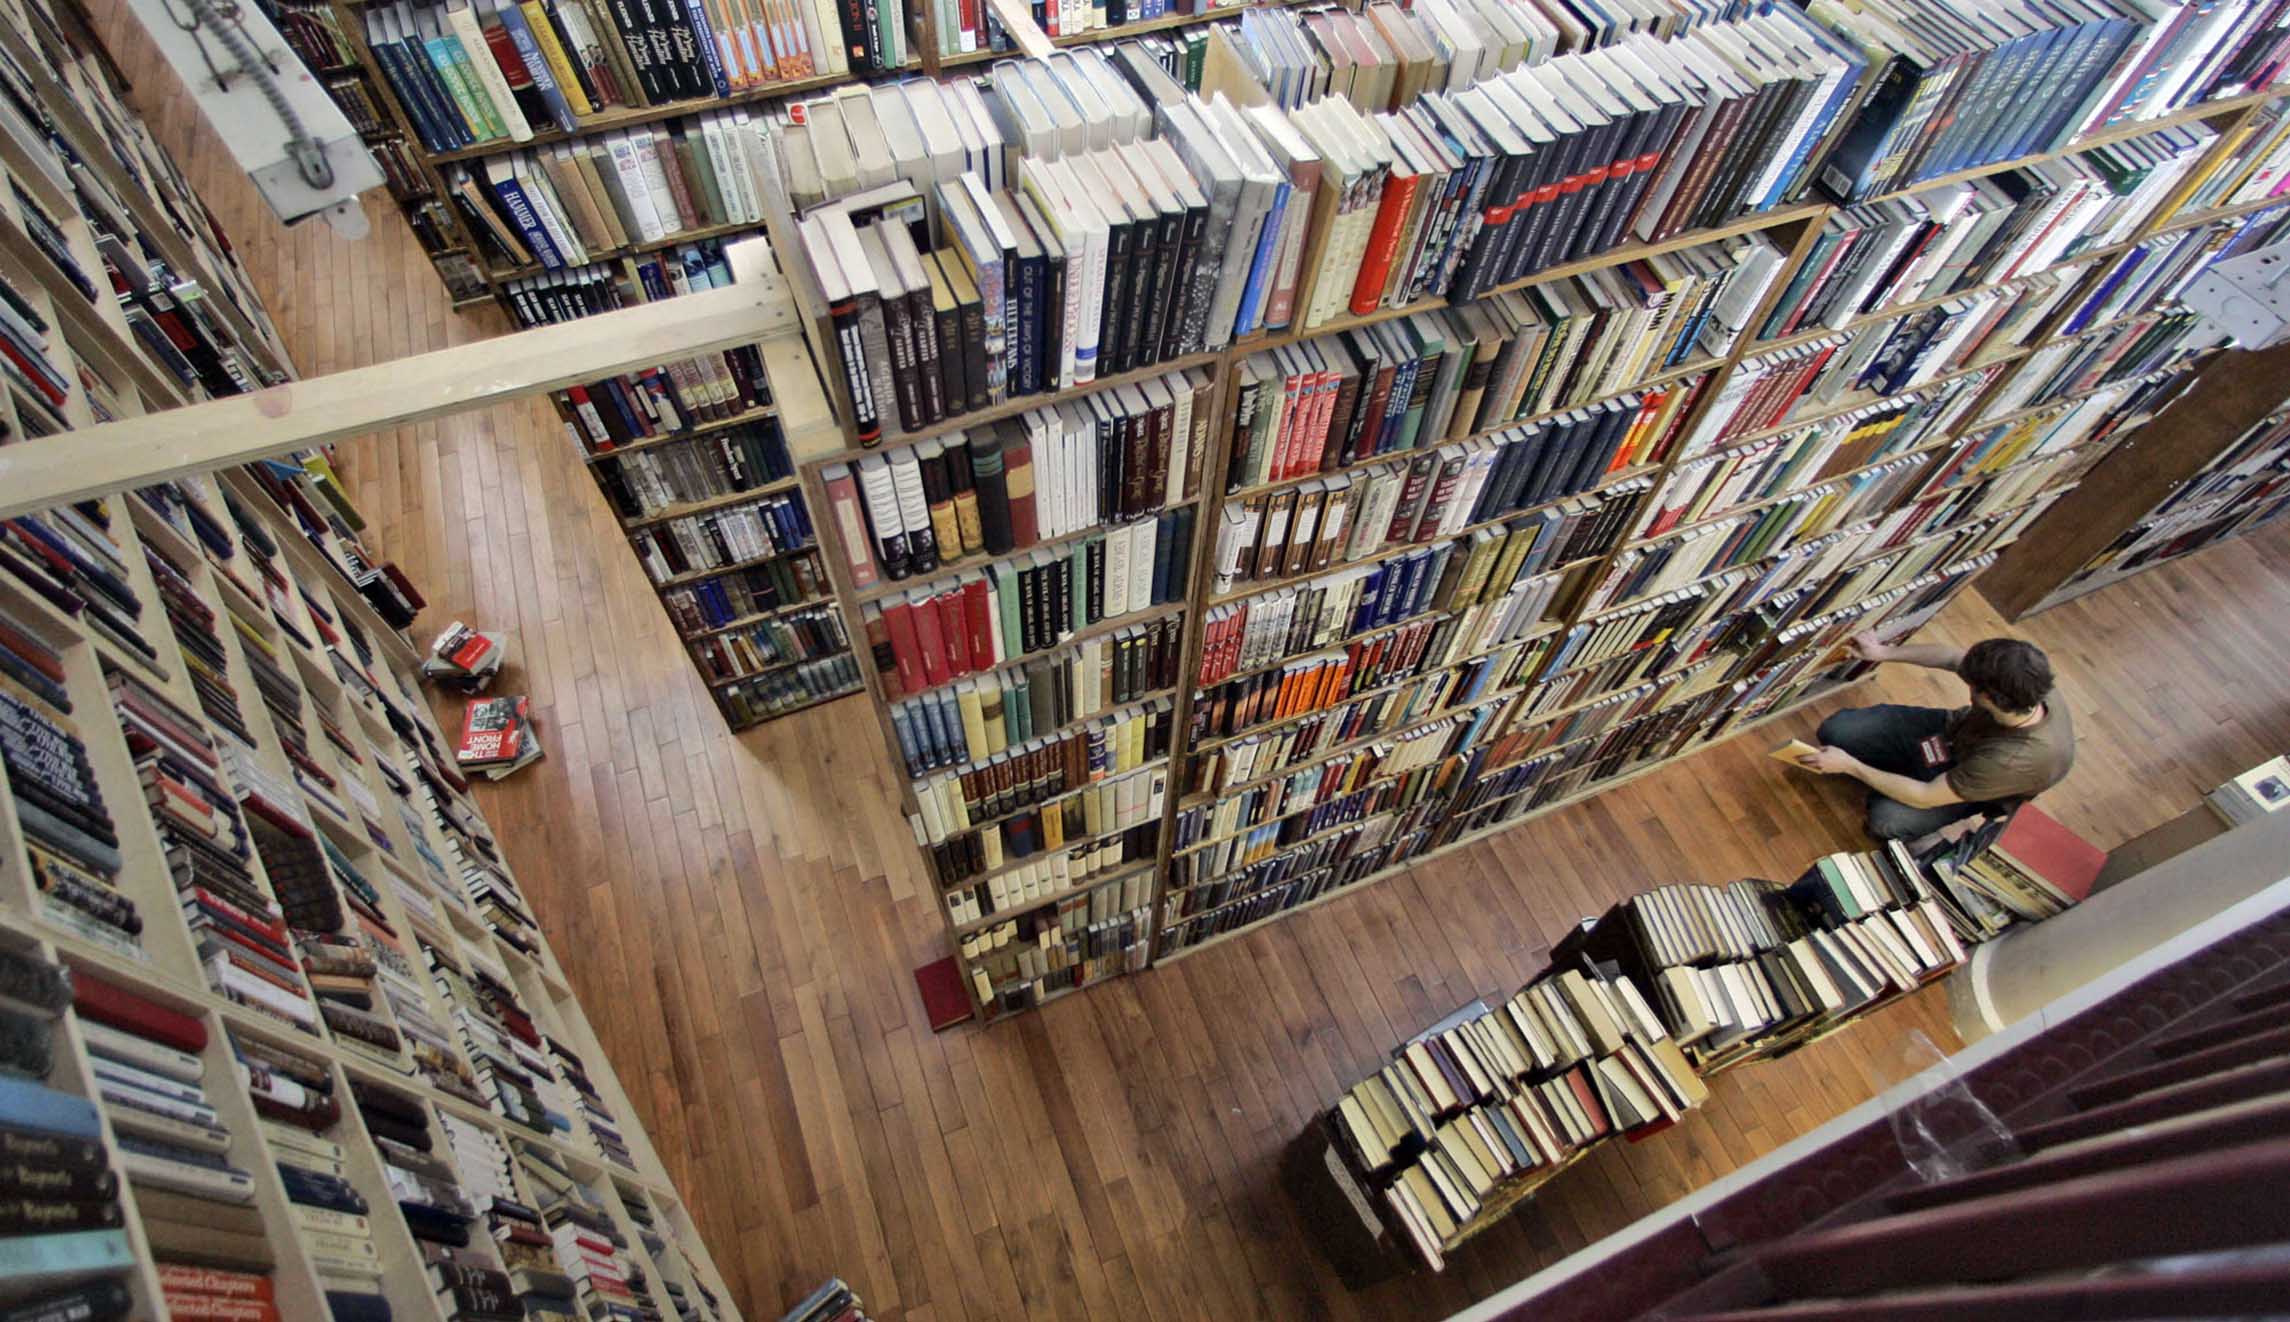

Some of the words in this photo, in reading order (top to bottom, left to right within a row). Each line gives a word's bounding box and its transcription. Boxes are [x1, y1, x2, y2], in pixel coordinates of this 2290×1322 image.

[504, 191, 537, 231] HAMMER
[1024, 265, 1033, 284] OUT
[1024, 287, 1033, 298] OF
[1023, 302, 1033, 316] THE
[1647, 291, 1676, 332] MIAMI
[1022, 343, 1032, 355] OF
[880, 361, 895, 403] AGENDA
[1021, 357, 1031, 389] VICTORY
[872, 378, 888, 421] NATION
[466, 733, 502, 745] FRONT
[471, 742, 501, 751] HOME
